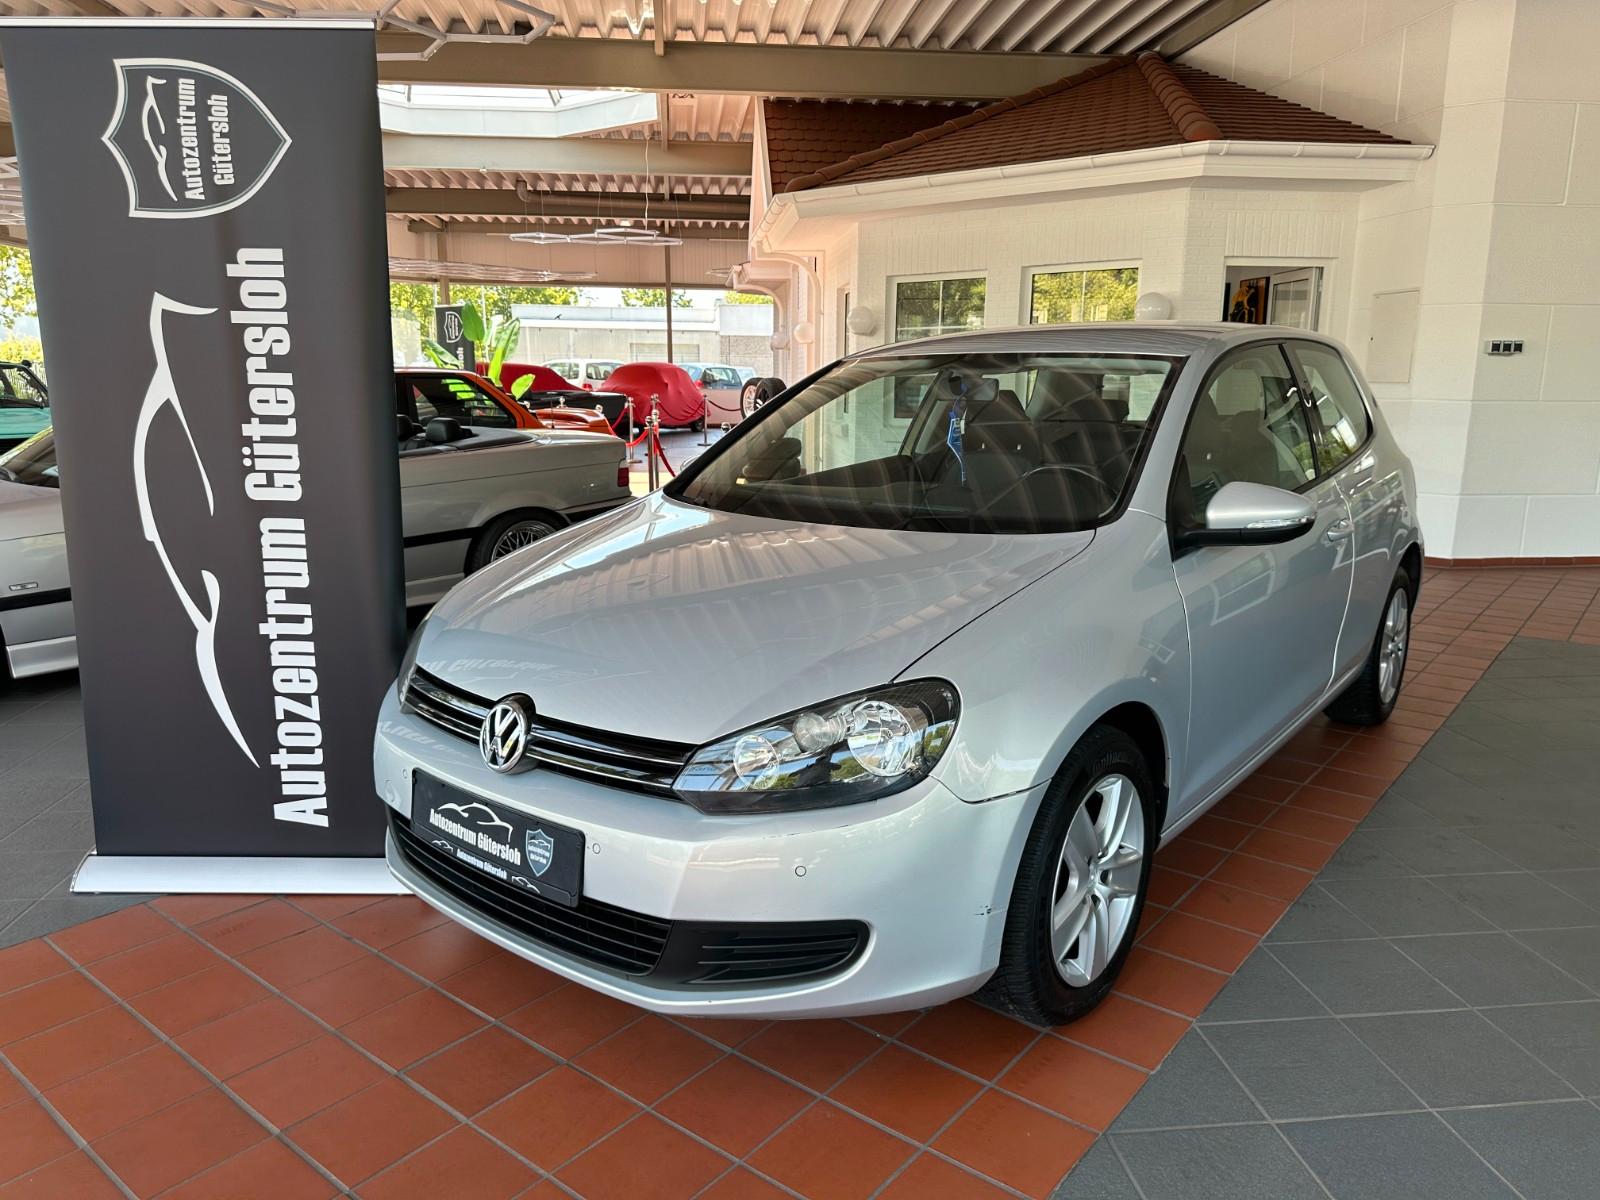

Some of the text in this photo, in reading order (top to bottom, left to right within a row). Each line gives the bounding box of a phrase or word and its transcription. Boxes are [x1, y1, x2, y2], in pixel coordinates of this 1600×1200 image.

[177, 78, 205, 200] Autozentrum
[208, 94, 235, 185] Gütersloh
[226, 247, 329, 828] Autozentrum Gütersloh
[430, 808, 521, 866] Autozentrum Gütersloh
